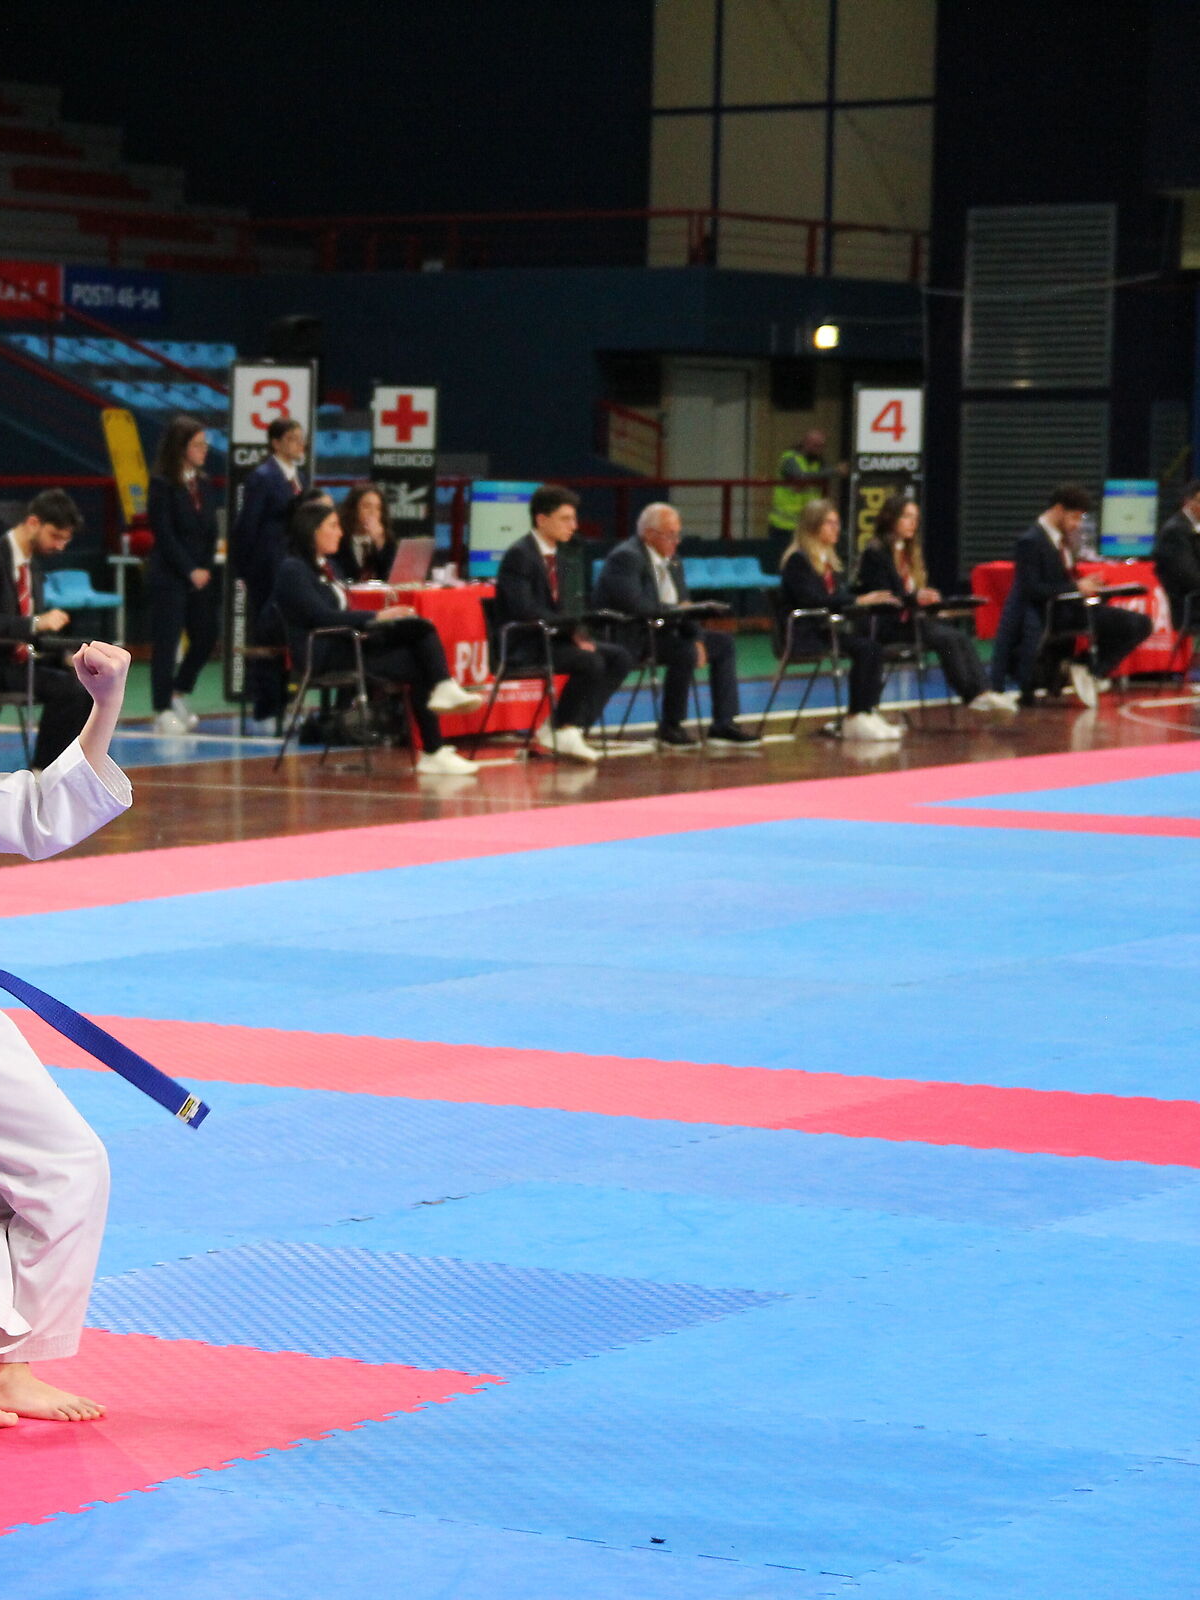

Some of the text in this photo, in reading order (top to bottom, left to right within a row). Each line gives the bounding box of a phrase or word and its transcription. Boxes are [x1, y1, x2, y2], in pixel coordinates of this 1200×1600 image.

[251, 379, 291, 430] 3
[871, 400, 907, 442] 4
[373, 453, 435, 467] MEDICO
[858, 457, 919, 471] CAMPO
